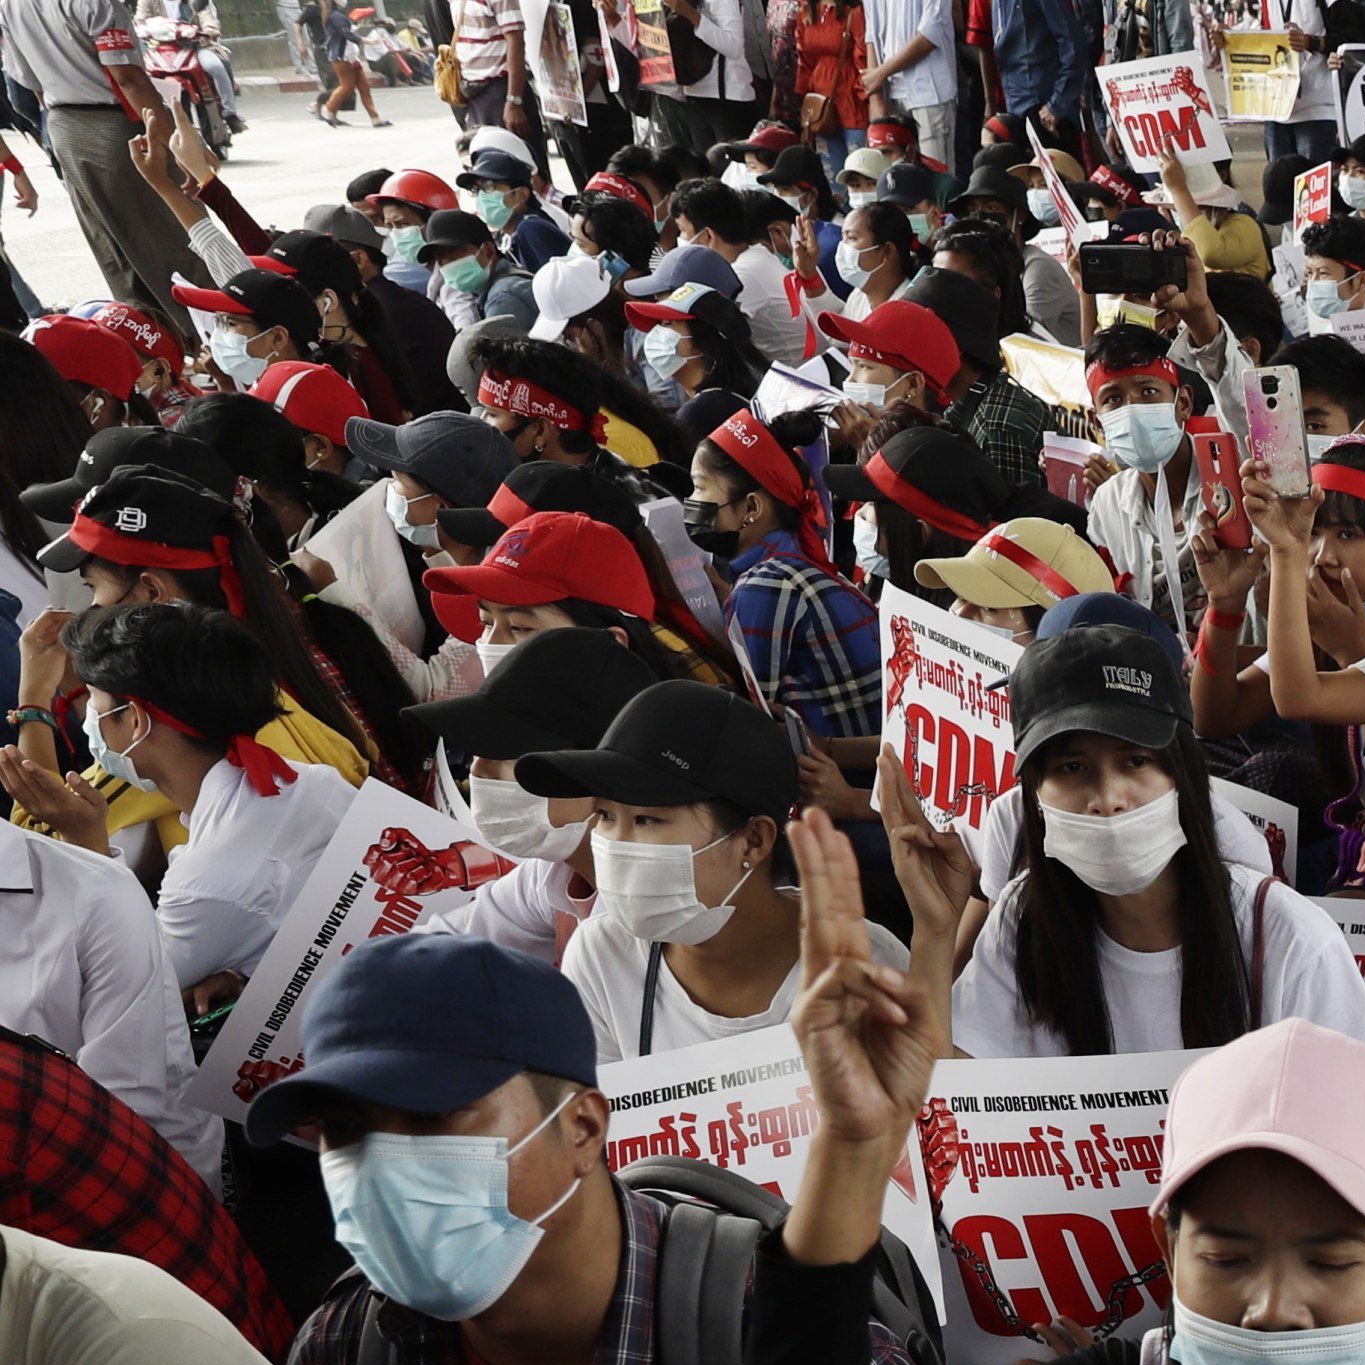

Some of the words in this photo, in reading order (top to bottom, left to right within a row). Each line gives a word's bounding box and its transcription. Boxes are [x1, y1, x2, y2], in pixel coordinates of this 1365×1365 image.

[1124, 105, 1207, 158] CDM
[1309, 174, 1326, 193] Our
[1339, 323, 1352, 333] WE
[494, 555, 520, 569] adidas
[910, 619, 928, 640] CIVIL
[927, 626, 973, 659] DISOBEDIENCE
[972, 647, 1011, 676] MOVEMENT
[1101, 665, 1153, 690] ITALY
[661, 750, 690, 770] Jeep
[903, 702, 1021, 832] CDM
[247, 1031, 277, 1063] CIVIL
[264, 946, 325, 1034] DISOBEDIENCE
[312, 869, 369, 951] MOVEMENT
[950, 1096, 981, 1113] CIVIL
[984, 1093, 1078, 1113] DISOBEDIENCE
[1080, 1088, 1170, 1110] MOVEMENT
[956, 1124, 1086, 1194] ရုံးမတက်နဲ့
